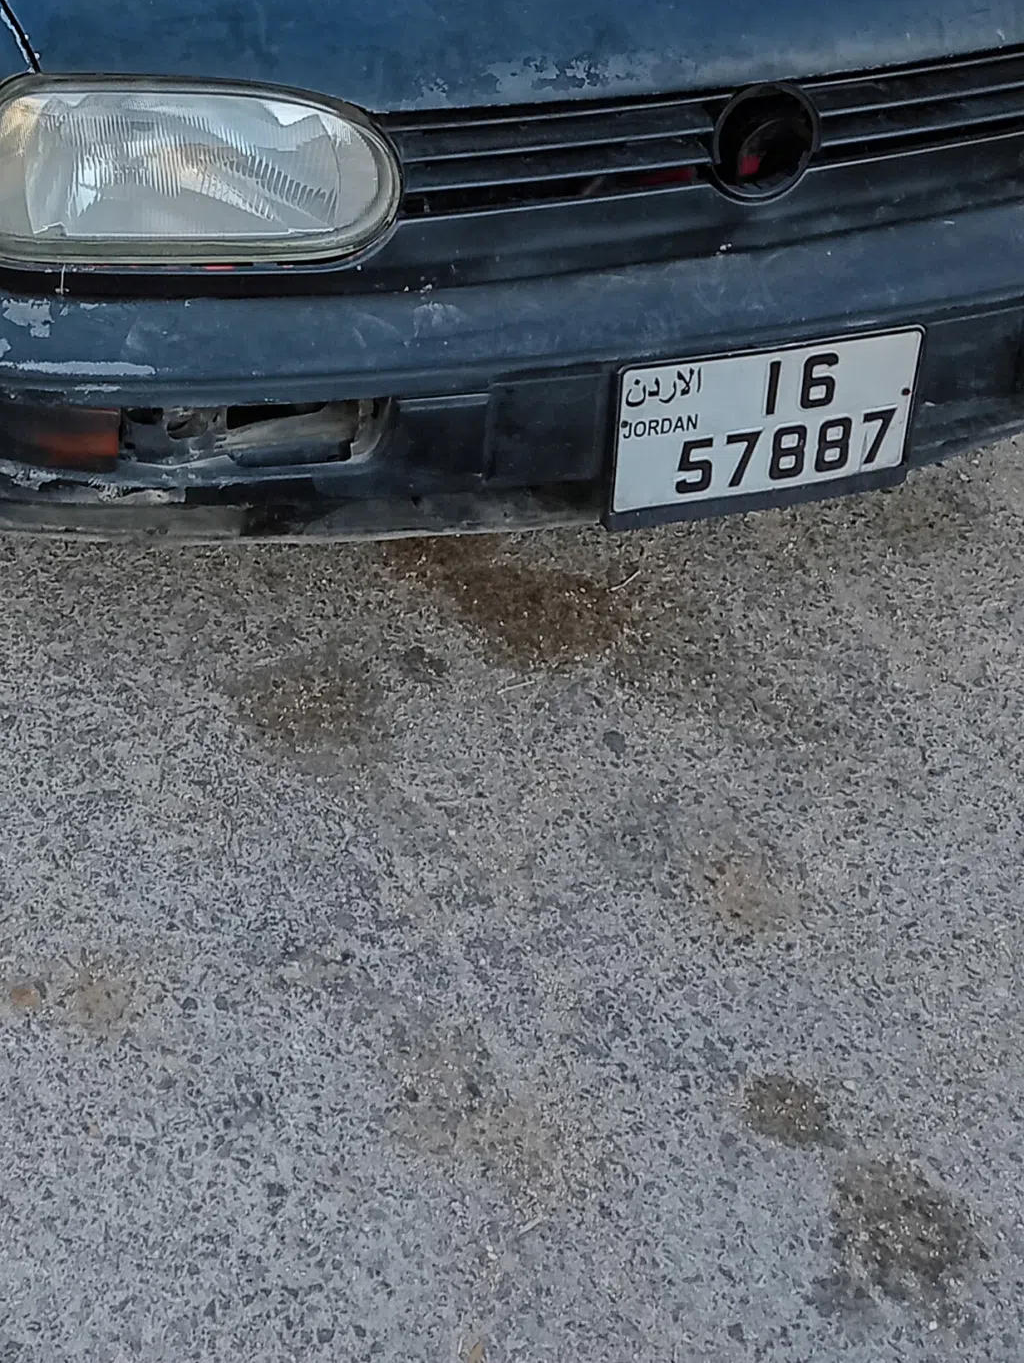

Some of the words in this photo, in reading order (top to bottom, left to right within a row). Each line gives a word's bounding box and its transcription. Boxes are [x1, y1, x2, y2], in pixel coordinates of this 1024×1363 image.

[766, 352, 839, 416] 16
[622, 414, 698, 438] JORDAN
[675, 408, 897, 495] 57887
